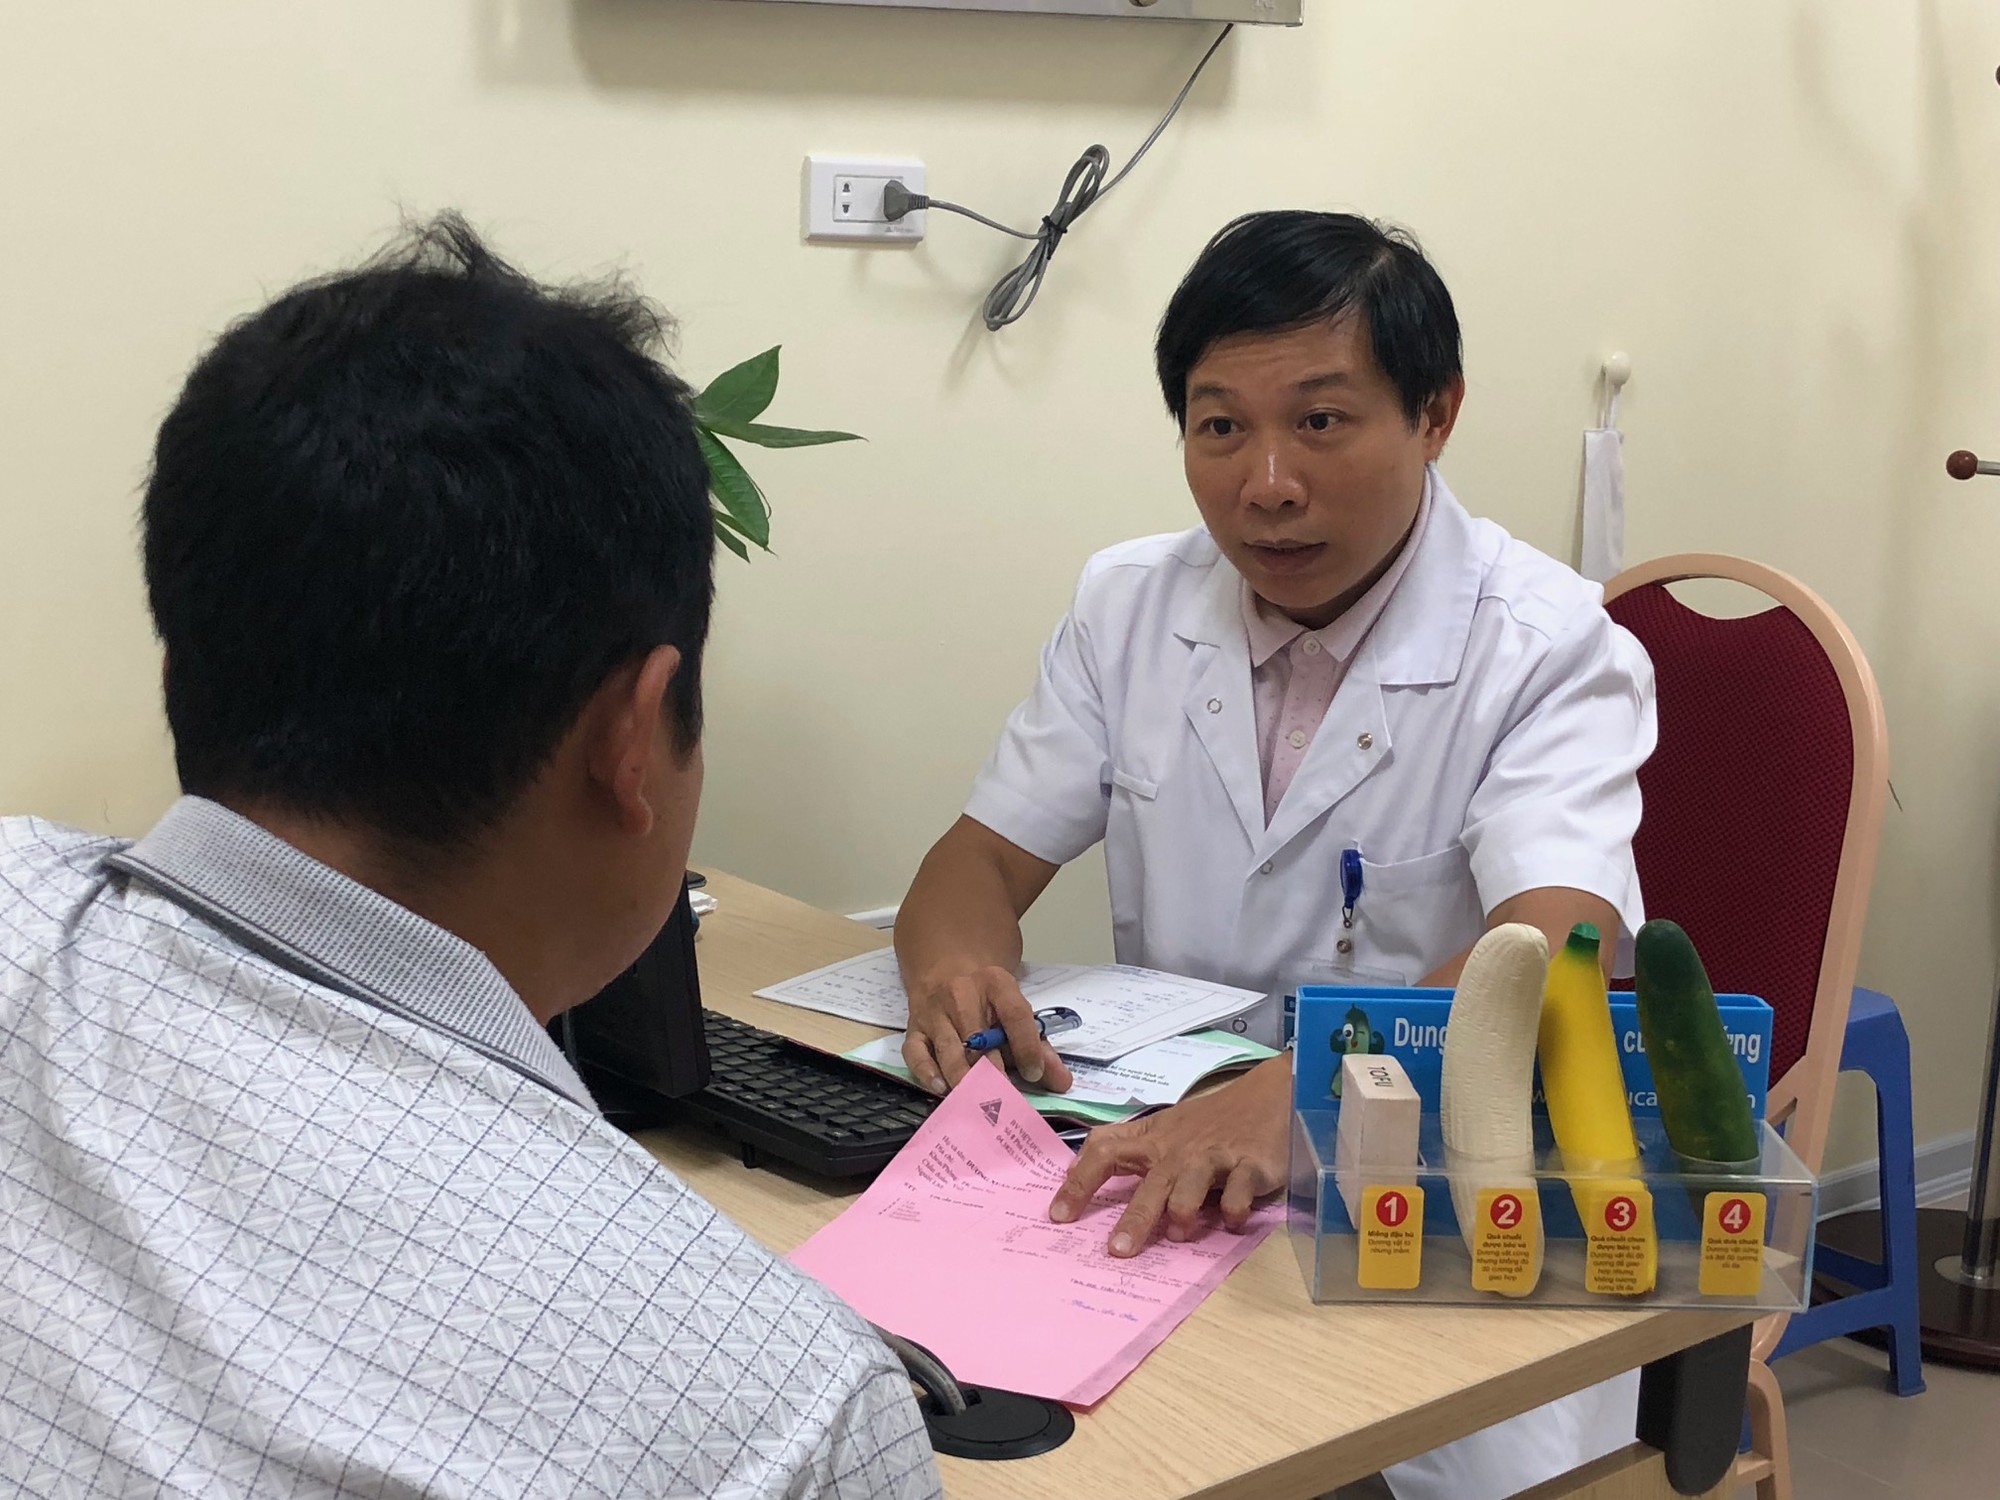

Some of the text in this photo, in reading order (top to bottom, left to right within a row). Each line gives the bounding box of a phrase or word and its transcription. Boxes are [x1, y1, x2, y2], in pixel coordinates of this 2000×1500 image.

[1367, 1066, 1394, 1087] TOFU
[1384, 1196, 1397, 1222] 1
[1497, 1199, 1516, 1224] 2
[1612, 1201, 1630, 1227] 3
[1723, 1204, 1743, 1229] 4
